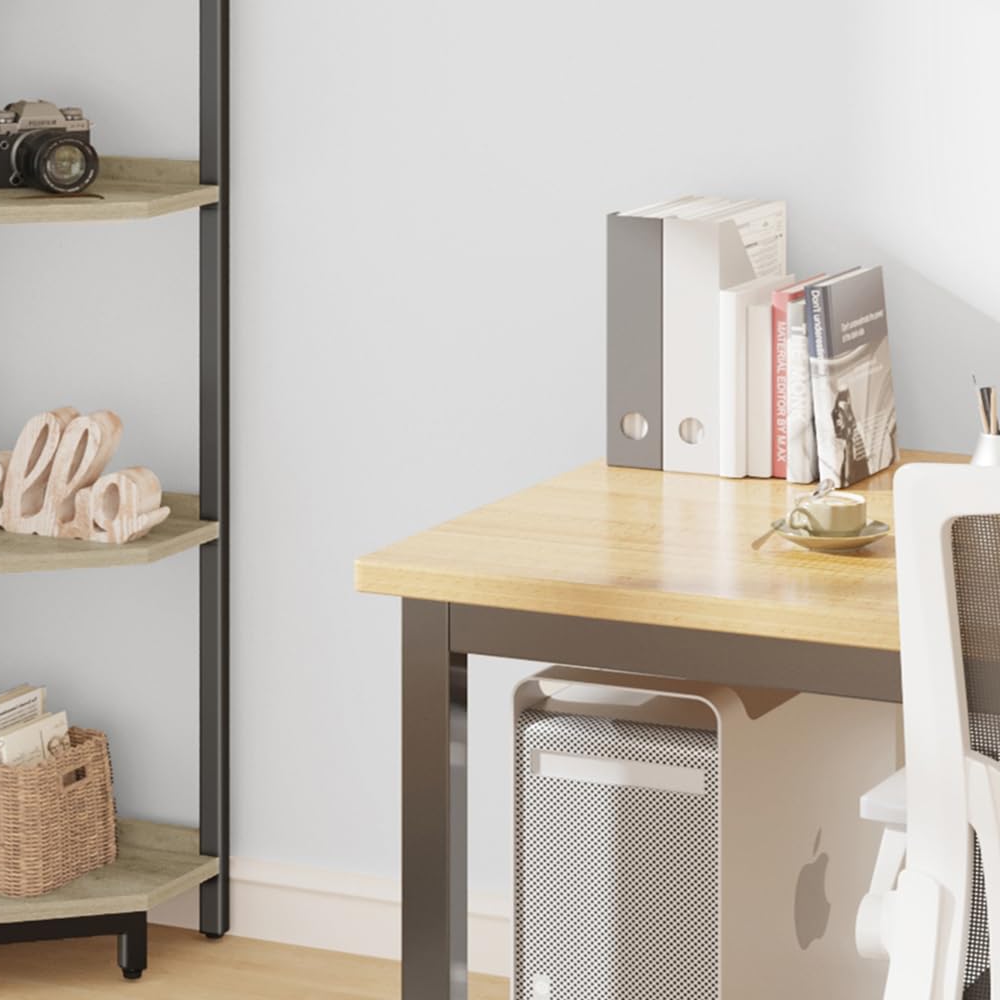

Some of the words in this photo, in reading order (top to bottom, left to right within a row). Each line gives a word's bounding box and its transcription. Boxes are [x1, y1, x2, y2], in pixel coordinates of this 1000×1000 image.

[776, 320, 787, 374] MATERIAL
[776, 376, 787, 416] EDITOR
[776, 418, 787, 434] BY
